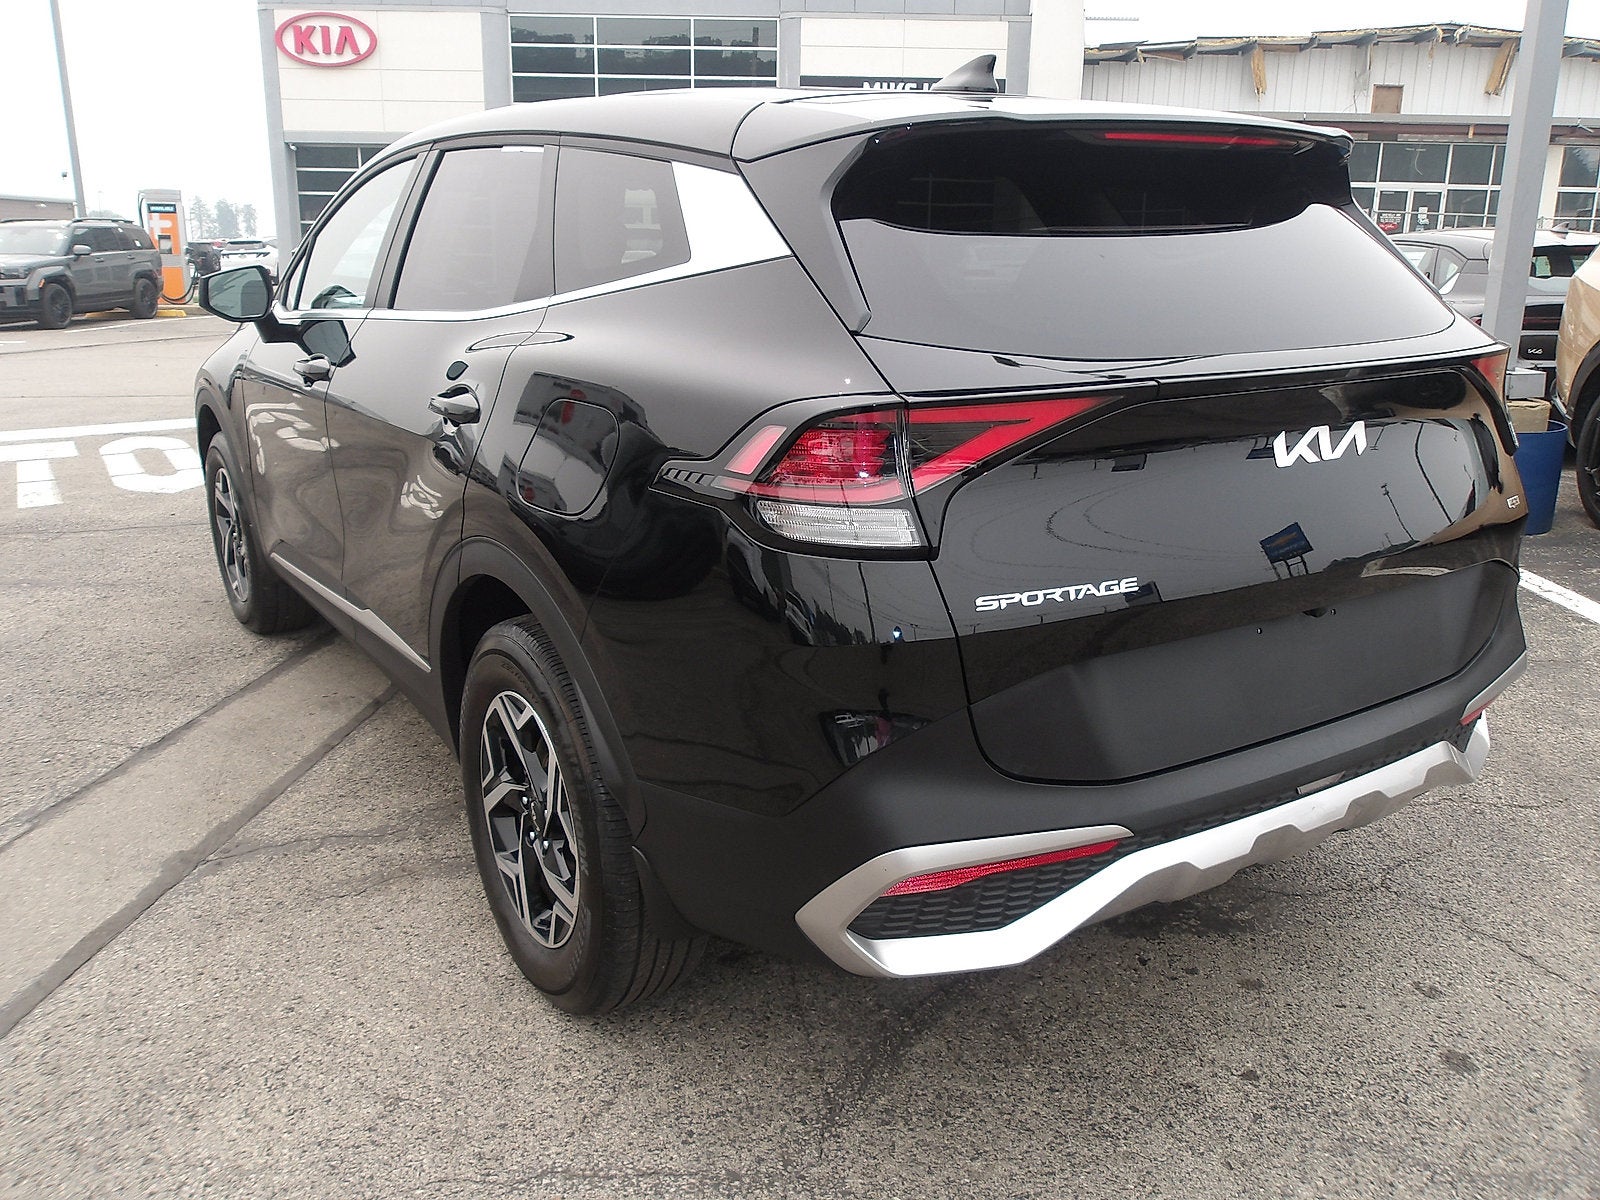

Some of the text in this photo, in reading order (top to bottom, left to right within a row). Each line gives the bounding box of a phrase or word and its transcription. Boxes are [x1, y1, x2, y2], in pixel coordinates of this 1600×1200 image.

[292, 24, 361, 55] KIA
[1273, 420, 1367, 468] KIA
[975, 576, 1140, 612] SPORTAGE
